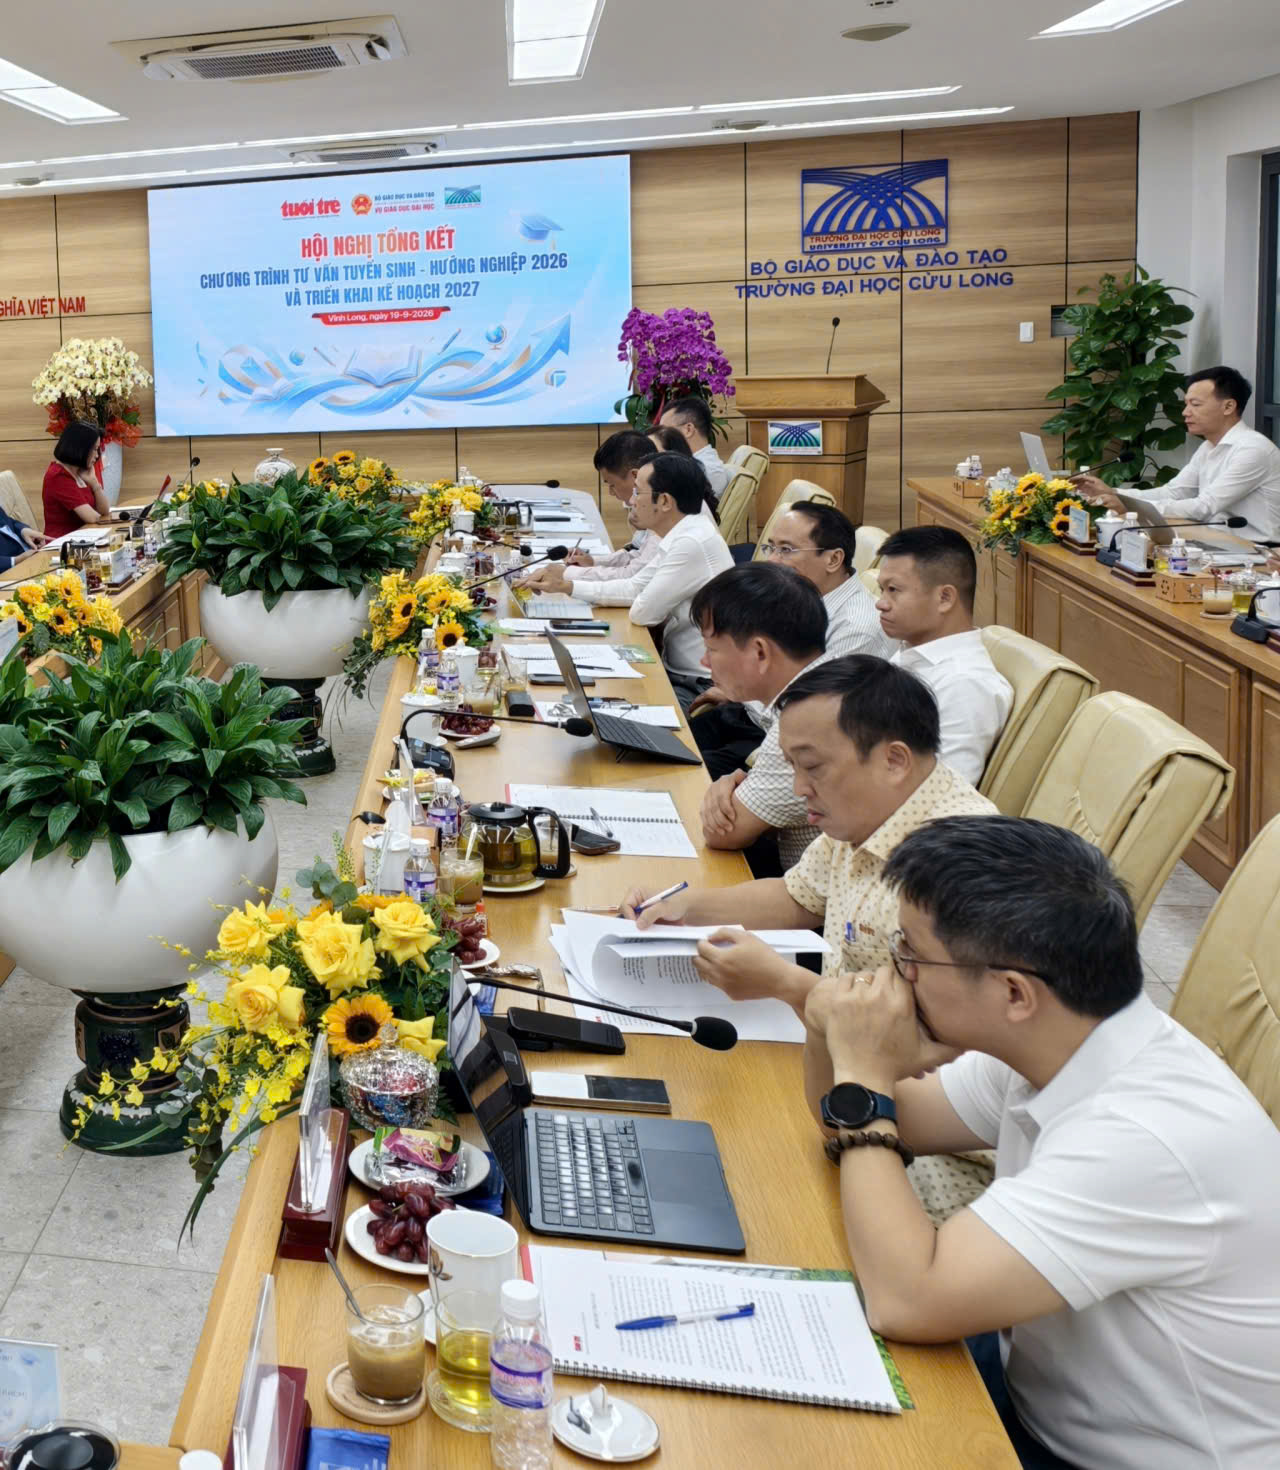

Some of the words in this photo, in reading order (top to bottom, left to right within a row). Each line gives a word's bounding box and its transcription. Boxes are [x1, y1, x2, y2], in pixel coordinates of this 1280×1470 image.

[301, 233, 328, 261] HỘI
[334, 234, 372, 260] NGHỊ
[377, 226, 419, 253] TỔNG
[425, 224, 455, 250] KẾT
[852, 232, 867, 241] ĐẠI
[870, 230, 889, 241] HỌC
[915, 228, 941, 237] LONG
[200, 271, 250, 289] CHƯƠNG
[254, 267, 289, 286] TRÌNH
[293, 267, 310, 284] TƯ
[314, 262, 339, 282] VẤN
[343, 259, 382, 281] TUYỂN
[386, 261, 416, 279] SINH
[430, 255, 476, 276] HƯỚNG
[480, 252, 527, 275] NGHIỆP
[531, 253, 568, 270] 2026
[750, 258, 777, 279] BỘ
[784, 254, 830, 273] GIÁO
[837, 255, 876, 275] DỤC
[883, 250, 908, 269] VÀ
[916, 248, 959, 267] ĐÀO
[969, 248, 1008, 268] TẠO
[285, 287, 302, 307] VÀ
[305, 284, 339, 306] TRIỂN
[344, 286, 373, 304] KHAI
[378, 281, 393, 302] KẾ
[397, 283, 440, 302] HOẠCH
[445, 281, 480, 298] 2027
[734, 281, 816, 299] TRƯỜNG
[822, 279, 854, 297] ĐẠI
[860, 277, 900, 295] HỌC
[908, 272, 952, 290] CỬU
[959, 271, 1014, 288] LONG
[28, 296, 56, 318] VIỆT
[58, 296, 86, 314] NAM
